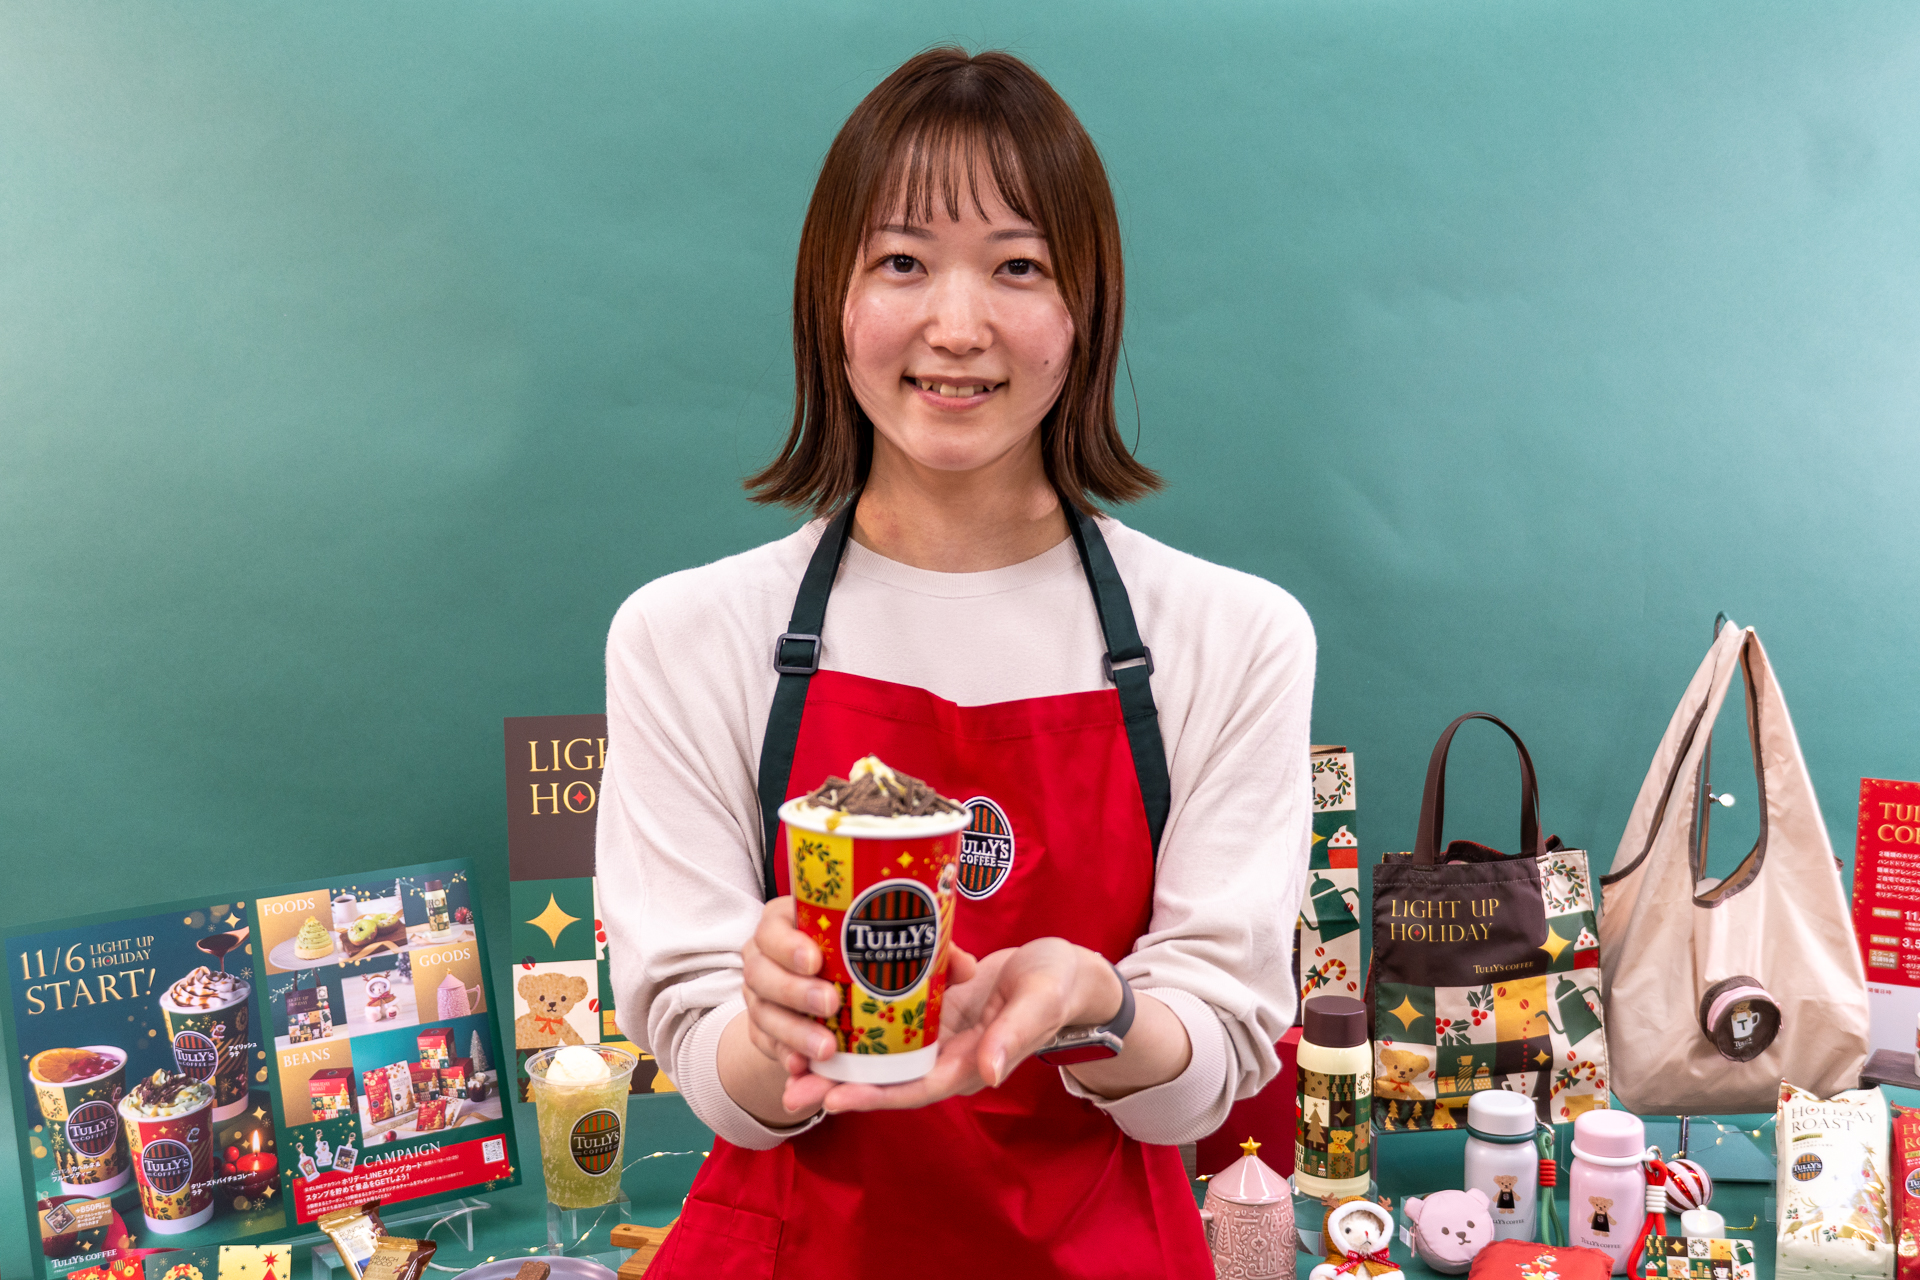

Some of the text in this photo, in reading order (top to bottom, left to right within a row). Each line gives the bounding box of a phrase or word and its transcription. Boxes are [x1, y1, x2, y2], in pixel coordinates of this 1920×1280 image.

[529, 780, 602, 815] HO
[961, 836, 1010, 859] ULLY'S
[960, 853, 997, 867] COFFEE
[263, 897, 316, 917] FOODS
[1391, 898, 1499, 919] LIGHT UP
[849, 924, 936, 950] TULLY'S
[1390, 922, 1492, 942] HOLIDAY
[20, 935, 155, 980] 11/6 LIGHT UP
[91, 949, 152, 969] HOLIDAY
[418, 947, 471, 967] GOODS
[864, 948, 921, 961] COFFEE
[1505, 960, 1534, 971] COFFEE
[25, 967, 156, 1016] START!
[228, 1042, 257, 1052] アイリッシュ
[229, 1050, 240, 1058] ラテ
[283, 1047, 331, 1068] BEANS
[1791, 1104, 1877, 1124] HOLIDAY
[1791, 1118, 1855, 1134] ROAST
[573, 1130, 620, 1149] TULLY'S
[583, 1144, 613, 1155] COFFEE
[363, 1141, 441, 1168] CAMPAIGN
[51, 1170, 92, 1183] フルーツティー
[153, 1168, 181, 1177] COFFEE
[191, 1188, 203, 1196] ラテ
[85, 1248, 118, 1261] COFFEE
